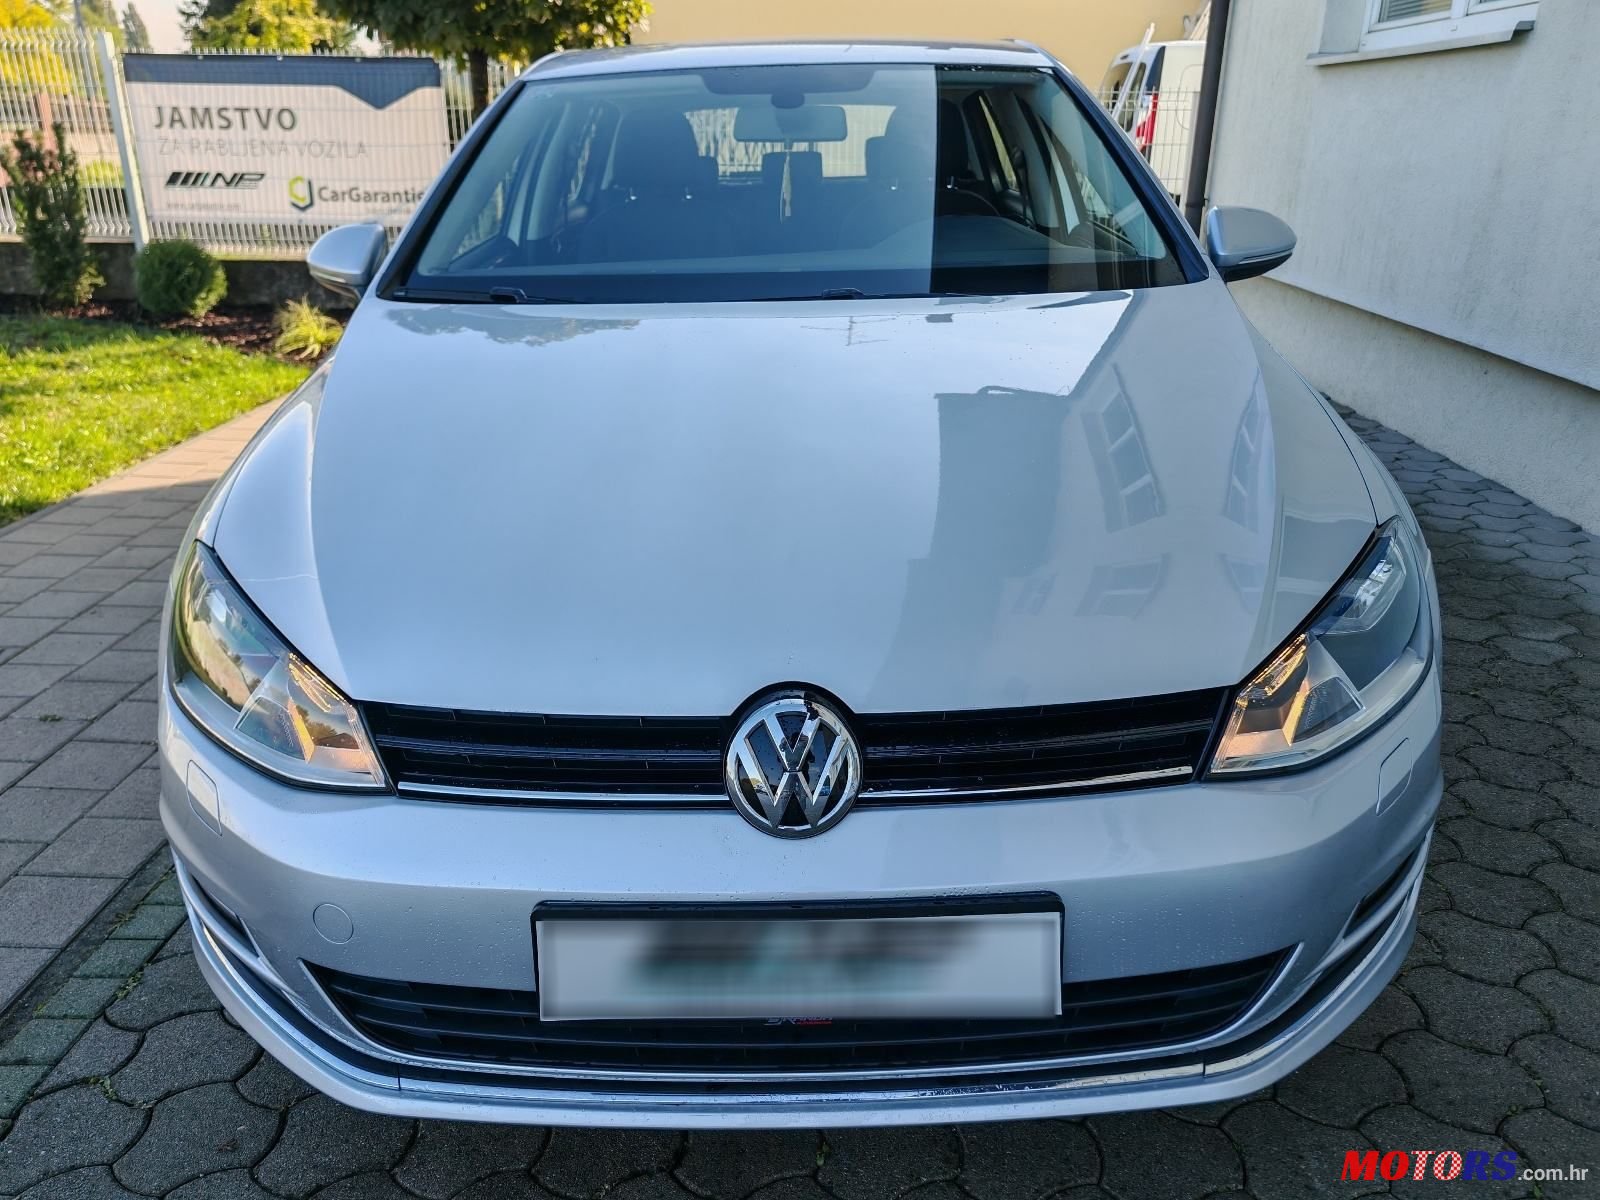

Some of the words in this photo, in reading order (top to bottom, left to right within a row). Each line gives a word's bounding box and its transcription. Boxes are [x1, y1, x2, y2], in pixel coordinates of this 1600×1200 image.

[154, 106, 296, 131] JAMSTVO
[159, 138, 184, 156] ZA
[190, 138, 290, 158] RABLJENA
[299, 140, 368, 159] VOZILA
